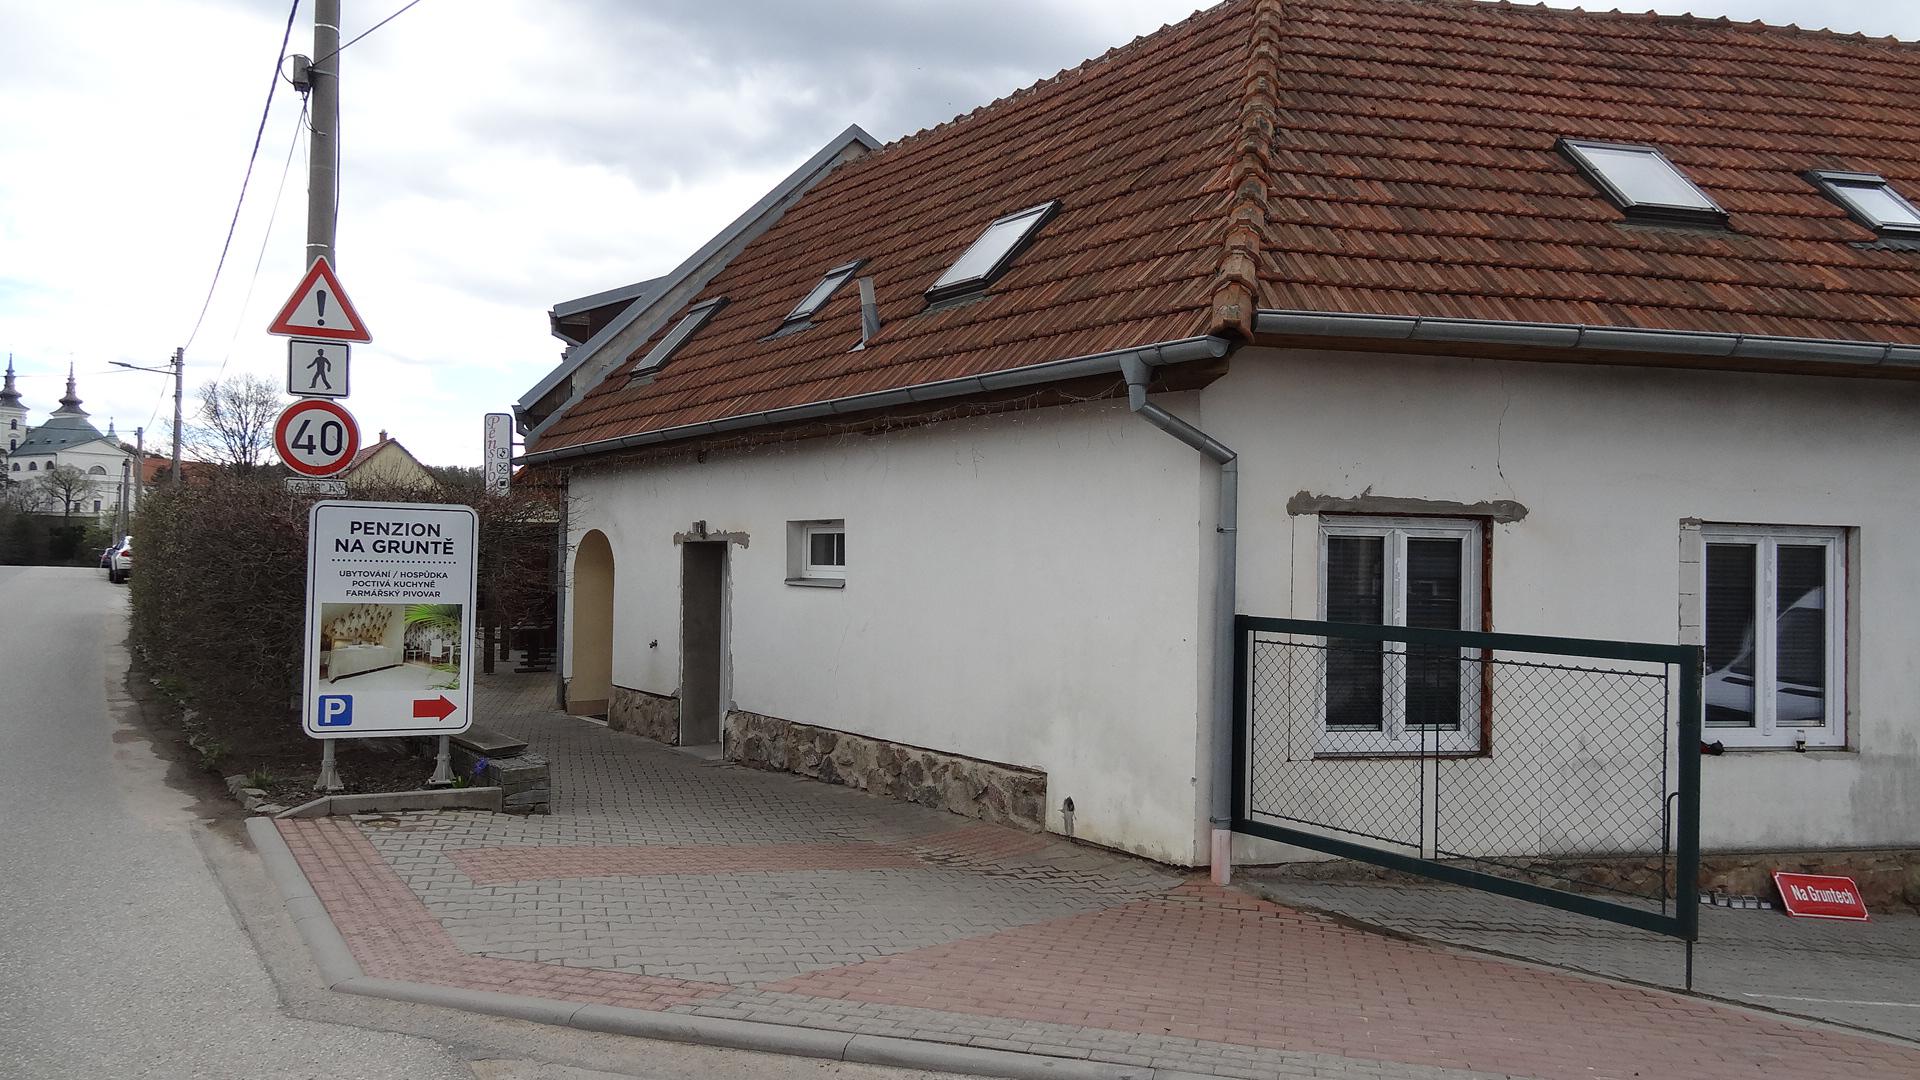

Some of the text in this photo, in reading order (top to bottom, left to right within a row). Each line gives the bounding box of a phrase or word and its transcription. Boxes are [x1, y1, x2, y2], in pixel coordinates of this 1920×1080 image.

[291, 419, 343, 456] 40
[487, 415, 500, 490] Pensio
[350, 521, 440, 537] PENZION
[335, 538, 454, 555] NA GRUNTĚ
[339, 570, 391, 578] UBYTOVÁNÍ
[399, 570, 448, 579] HOSPŮDKA
[352, 579, 436, 588] POCTIVÁ KUCHYNĚ
[346, 589, 441, 598] FARMÁŘSKÝ PIVOVAR
[325, 699, 346, 724] P
[1790, 884, 1856, 904] Na Gruntech
